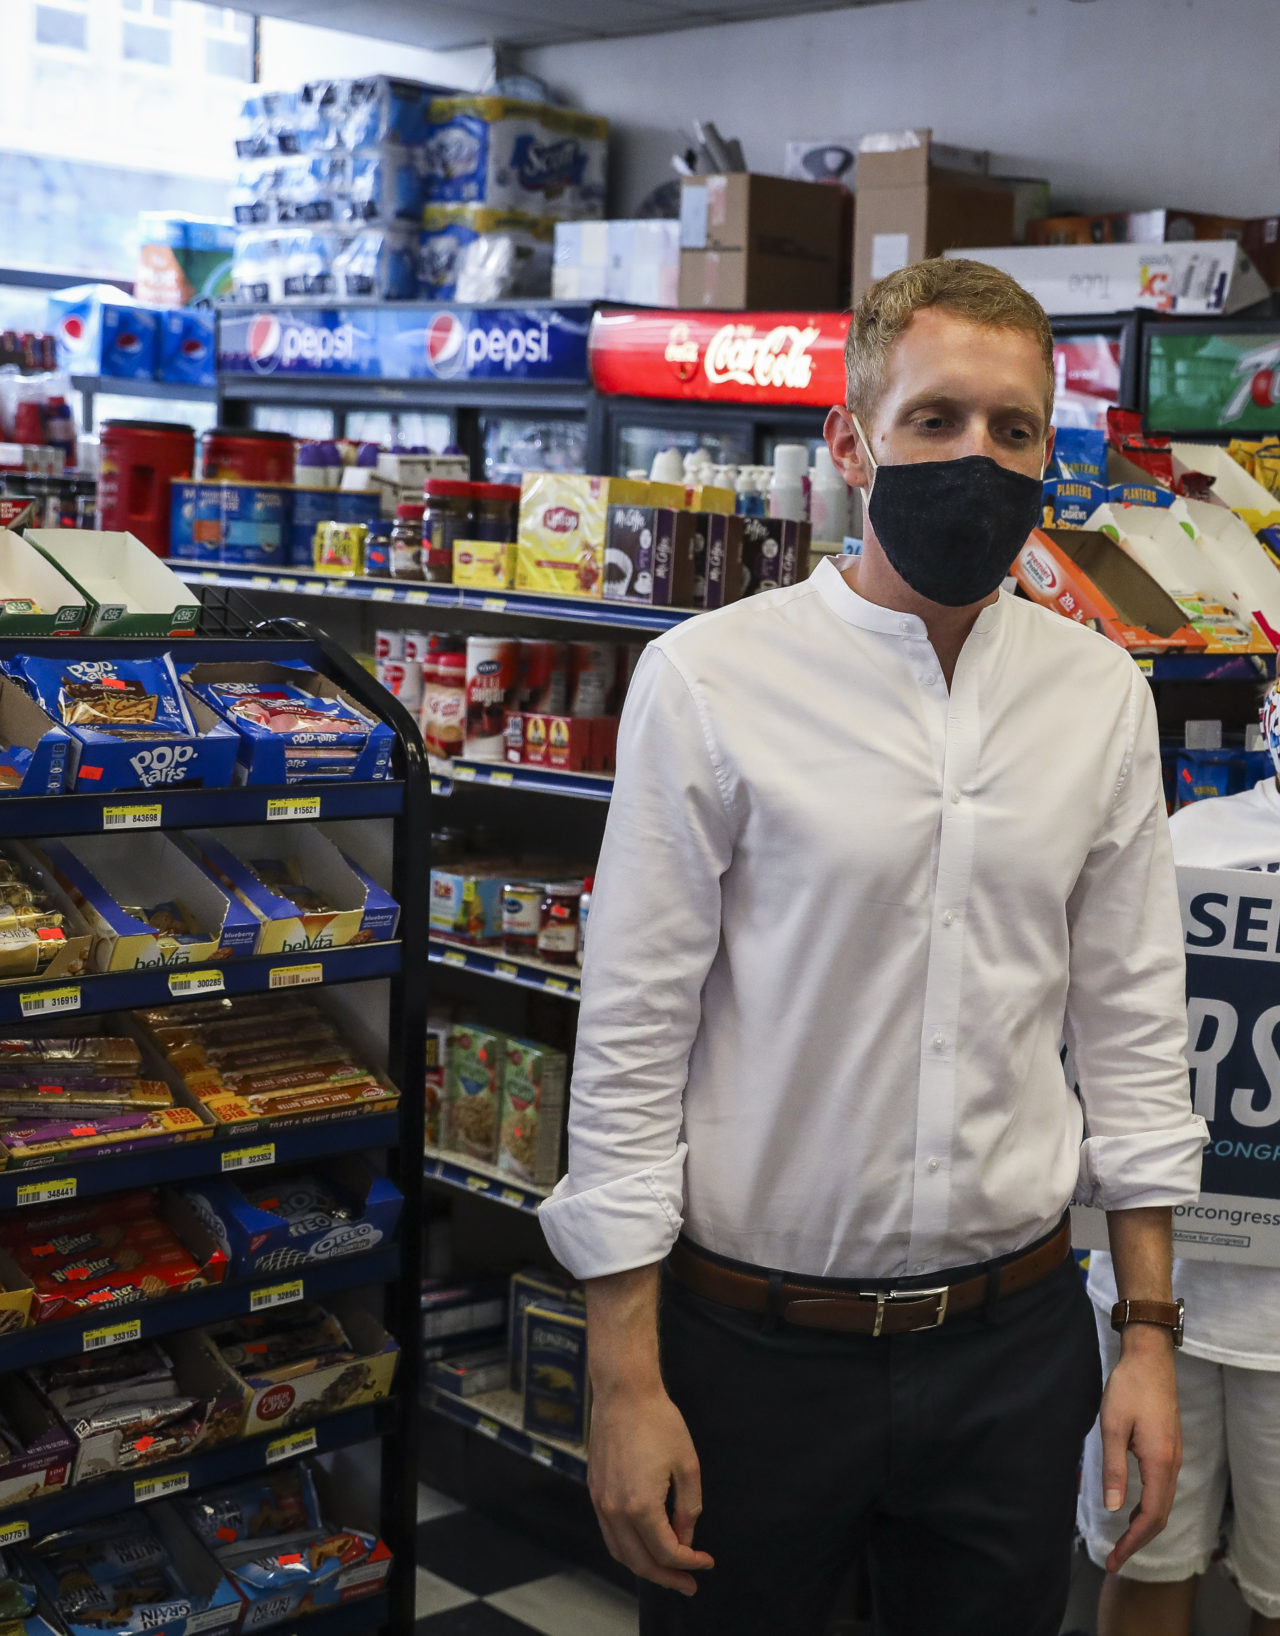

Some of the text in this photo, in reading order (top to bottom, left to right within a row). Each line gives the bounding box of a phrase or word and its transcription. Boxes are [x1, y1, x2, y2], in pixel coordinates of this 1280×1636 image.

[281, 322, 352, 368] pepsi
[466, 320, 549, 371] pepsi
[1056, 483, 1092, 500] PLANTERS
[1123, 488, 1157, 503] PLANTERS
[1061, 509, 1087, 521] CASHEWS
[1025, 559, 1045, 583] Protein
[1026, 550, 1052, 580] Premier
[277, 706, 308, 714] cherry
[139, 765, 187, 788] tarts
[294, 806, 317, 815] 815621
[132, 813, 158, 823] 843698
[364, 914, 393, 923] blueberry
[224, 931, 255, 940] blueberry
[52, 995, 78, 1007] 316919
[164, 1108, 191, 1119] BIG
[47, 1188, 74, 1199] 348441
[289, 1216, 331, 1237] REO
[316, 1227, 370, 1253] OREO
[1211, 1236, 1244, 1245] Congress
[113, 1329, 138, 1342] 333153
[74, 1422, 88, 1435] 12
[140, 1603, 191, 1622] GRAIN
